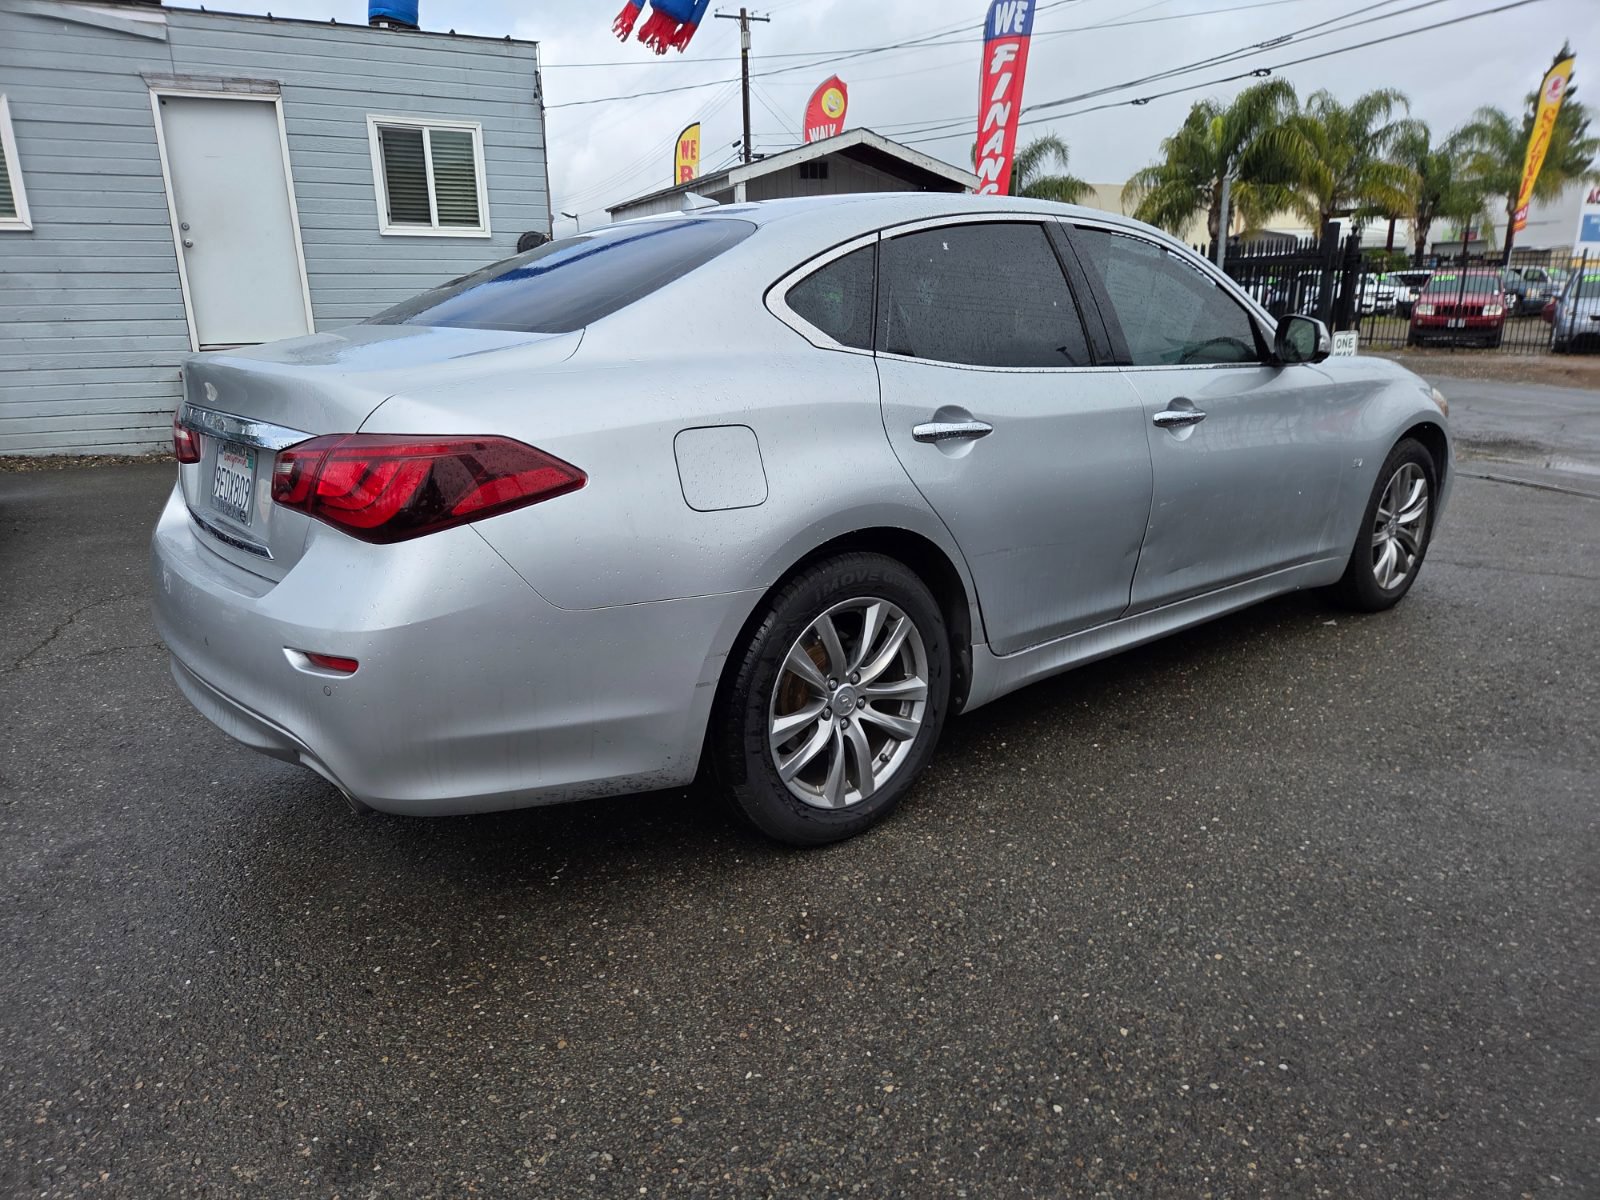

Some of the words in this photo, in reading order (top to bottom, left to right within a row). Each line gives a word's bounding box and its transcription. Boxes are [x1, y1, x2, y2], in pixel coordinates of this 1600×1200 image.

[994, 1, 1028, 35] WE
[808, 123, 836, 143] WALK
[680, 139, 697, 160] WE
[1336, 337, 1353, 349] ONE
